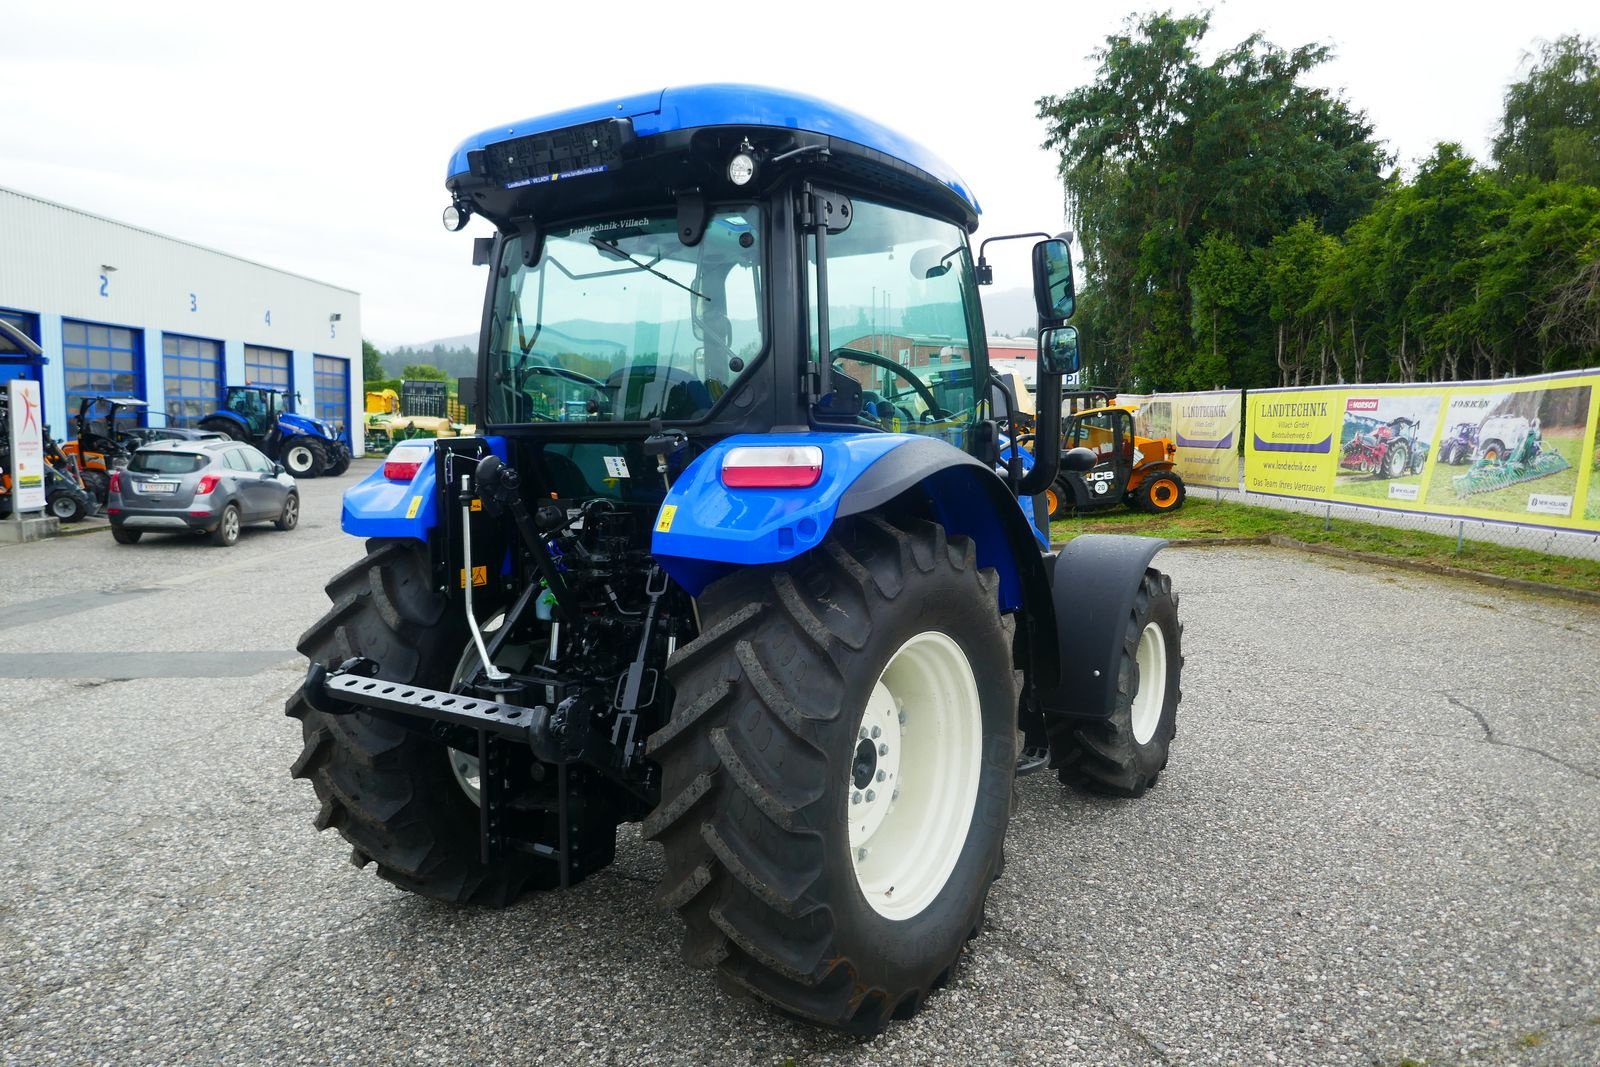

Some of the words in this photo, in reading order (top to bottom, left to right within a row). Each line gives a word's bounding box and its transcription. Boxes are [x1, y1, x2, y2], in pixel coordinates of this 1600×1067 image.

[569, 217, 649, 236] Landtechnik-Villach
[100, 275, 109, 297] 2
[190, 293, 197, 312] 3
[264, 310, 271, 327] 4
[330, 324, 336, 339] 5
[1261, 402, 1328, 417] LANDTECHNIK
[1451, 399, 1491, 408] JOSKIN
[1086, 471, 1114, 481] JCB
[1253, 478, 1263, 487] Das
[1264, 479, 1278, 488] Team
[1294, 482, 1326, 493] Vertrauens
